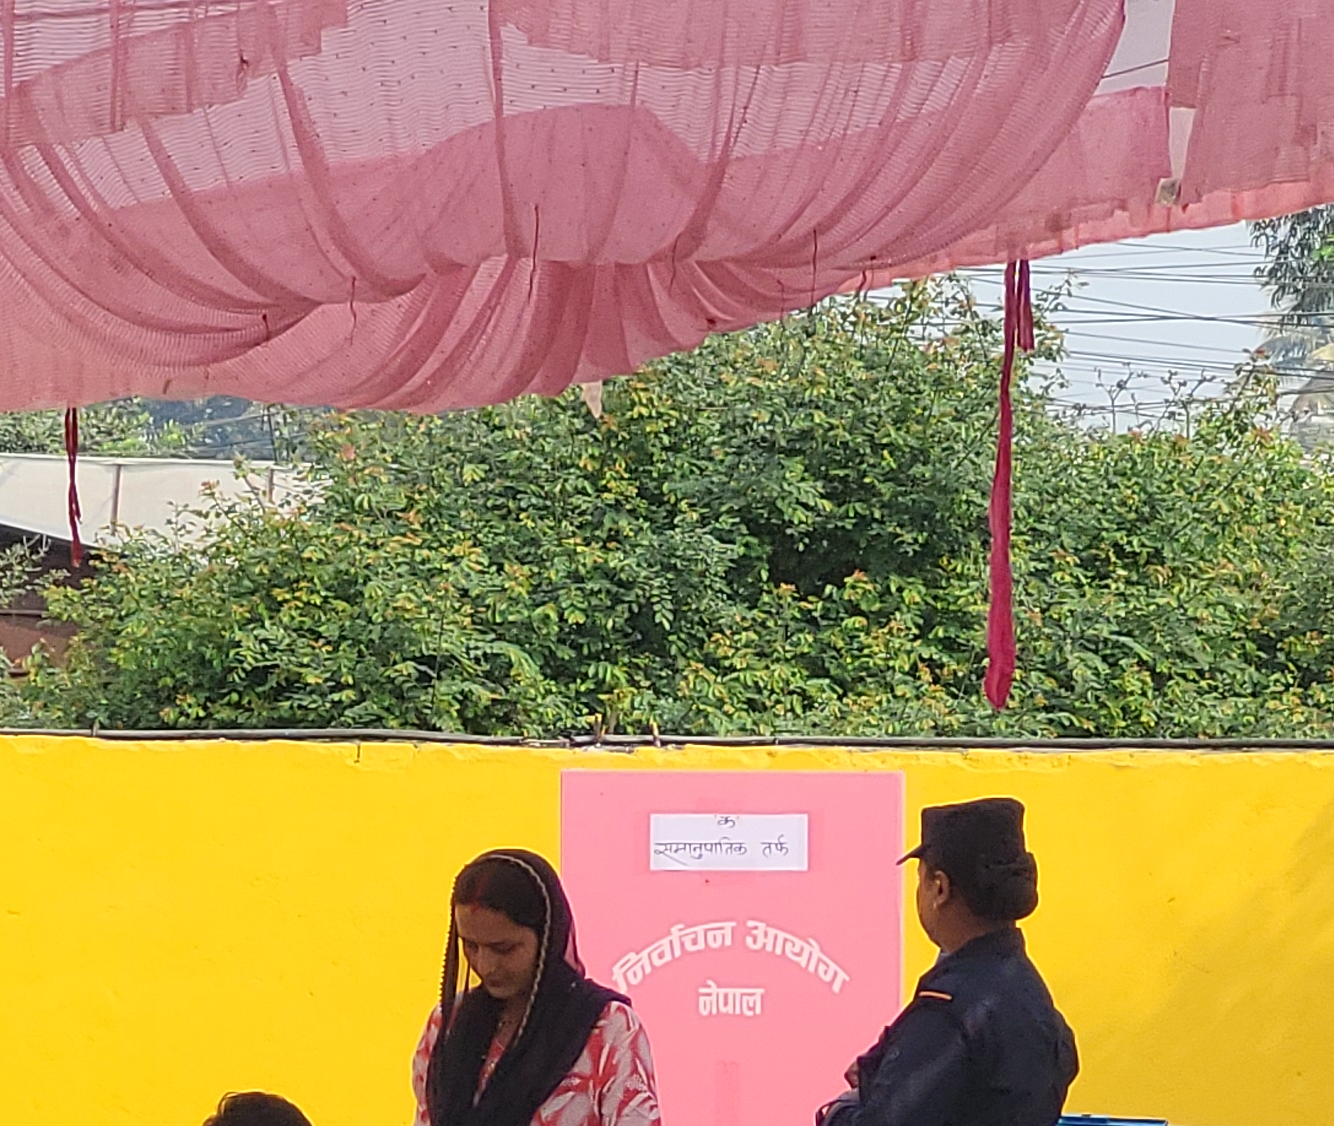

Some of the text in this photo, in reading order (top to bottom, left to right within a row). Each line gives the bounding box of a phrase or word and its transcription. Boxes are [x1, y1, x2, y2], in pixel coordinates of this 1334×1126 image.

[654, 834, 789, 866] समानुपातिक तर्फ
[611, 920, 850, 994] निर्वाचन आयोग
[698, 979, 764, 1016] नेपाल
